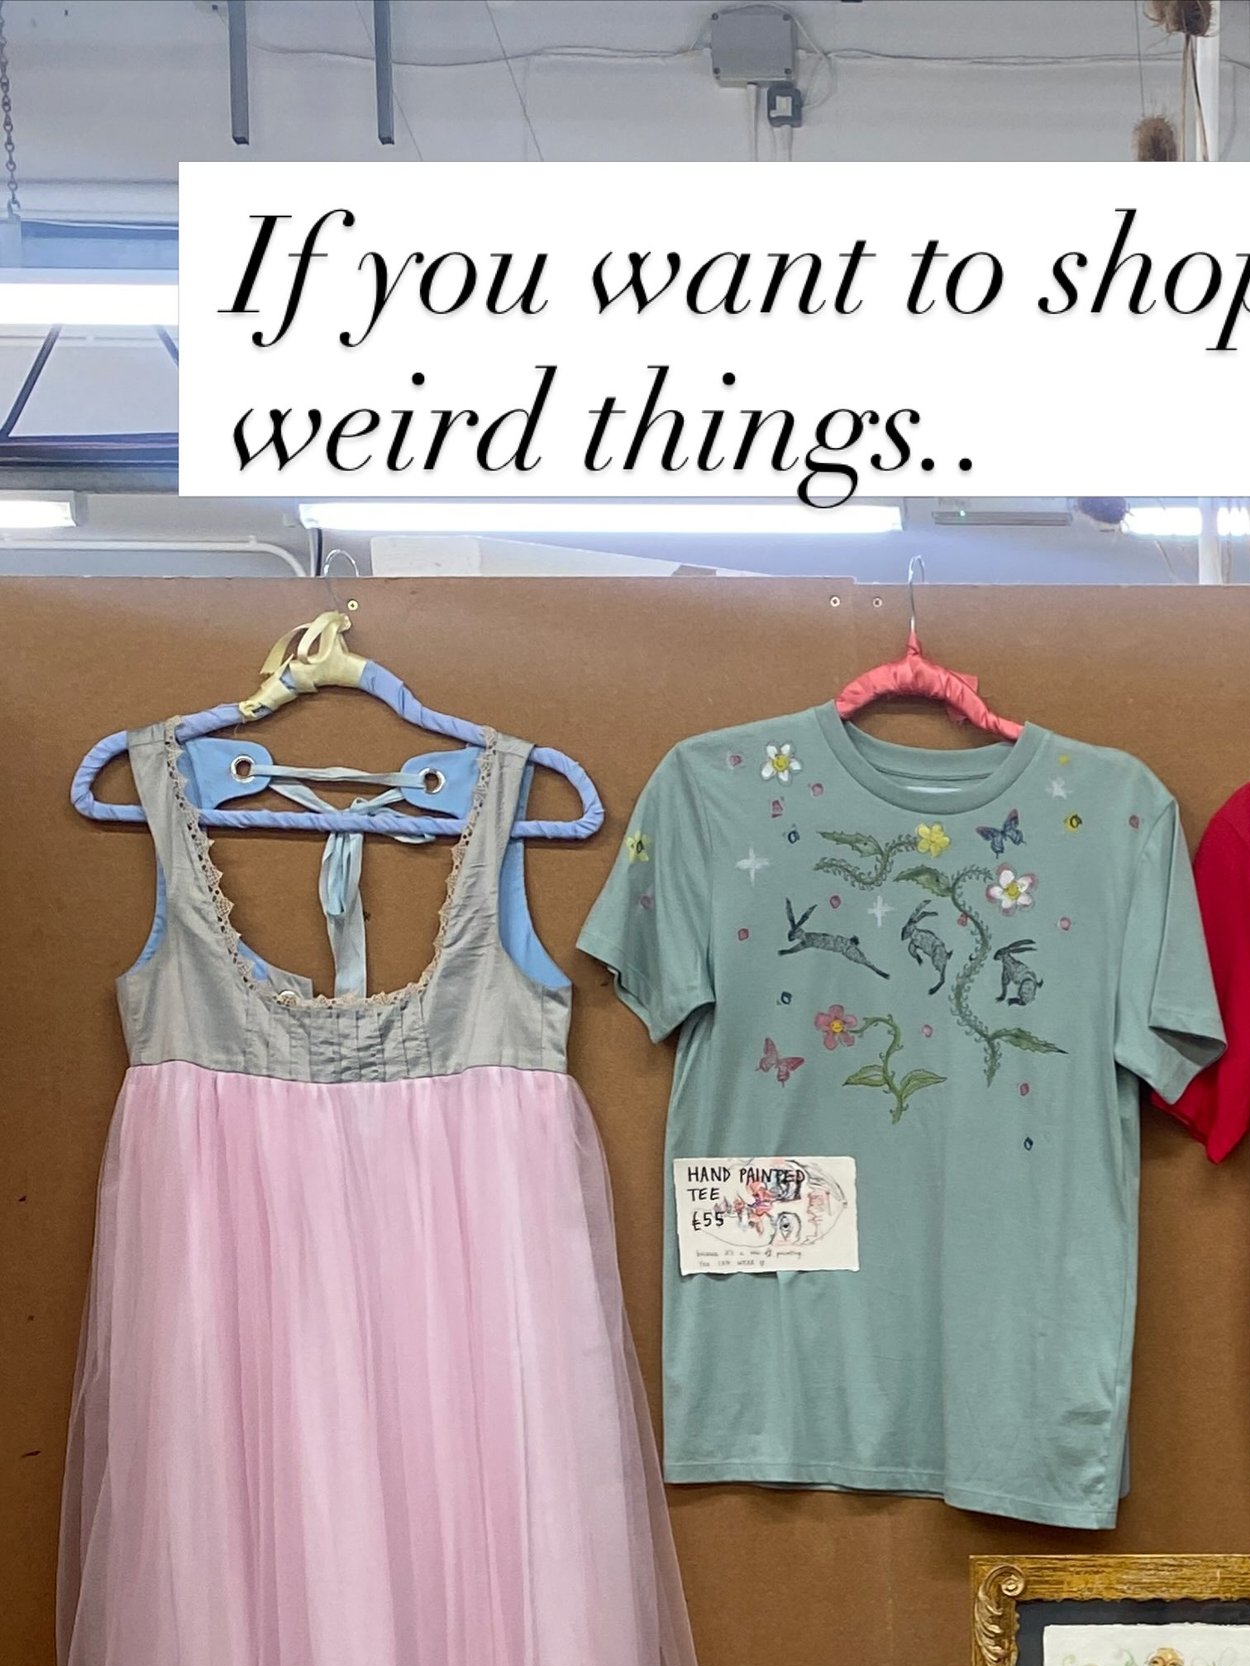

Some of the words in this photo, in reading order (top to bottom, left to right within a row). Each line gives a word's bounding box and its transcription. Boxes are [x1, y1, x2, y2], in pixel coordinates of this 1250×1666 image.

[687, 1166, 732, 1183] HAND
[739, 1167, 806, 1183] PAINTED
[687, 1188, 720, 1201] TEE
[692, 1211, 726, 1231] £55
